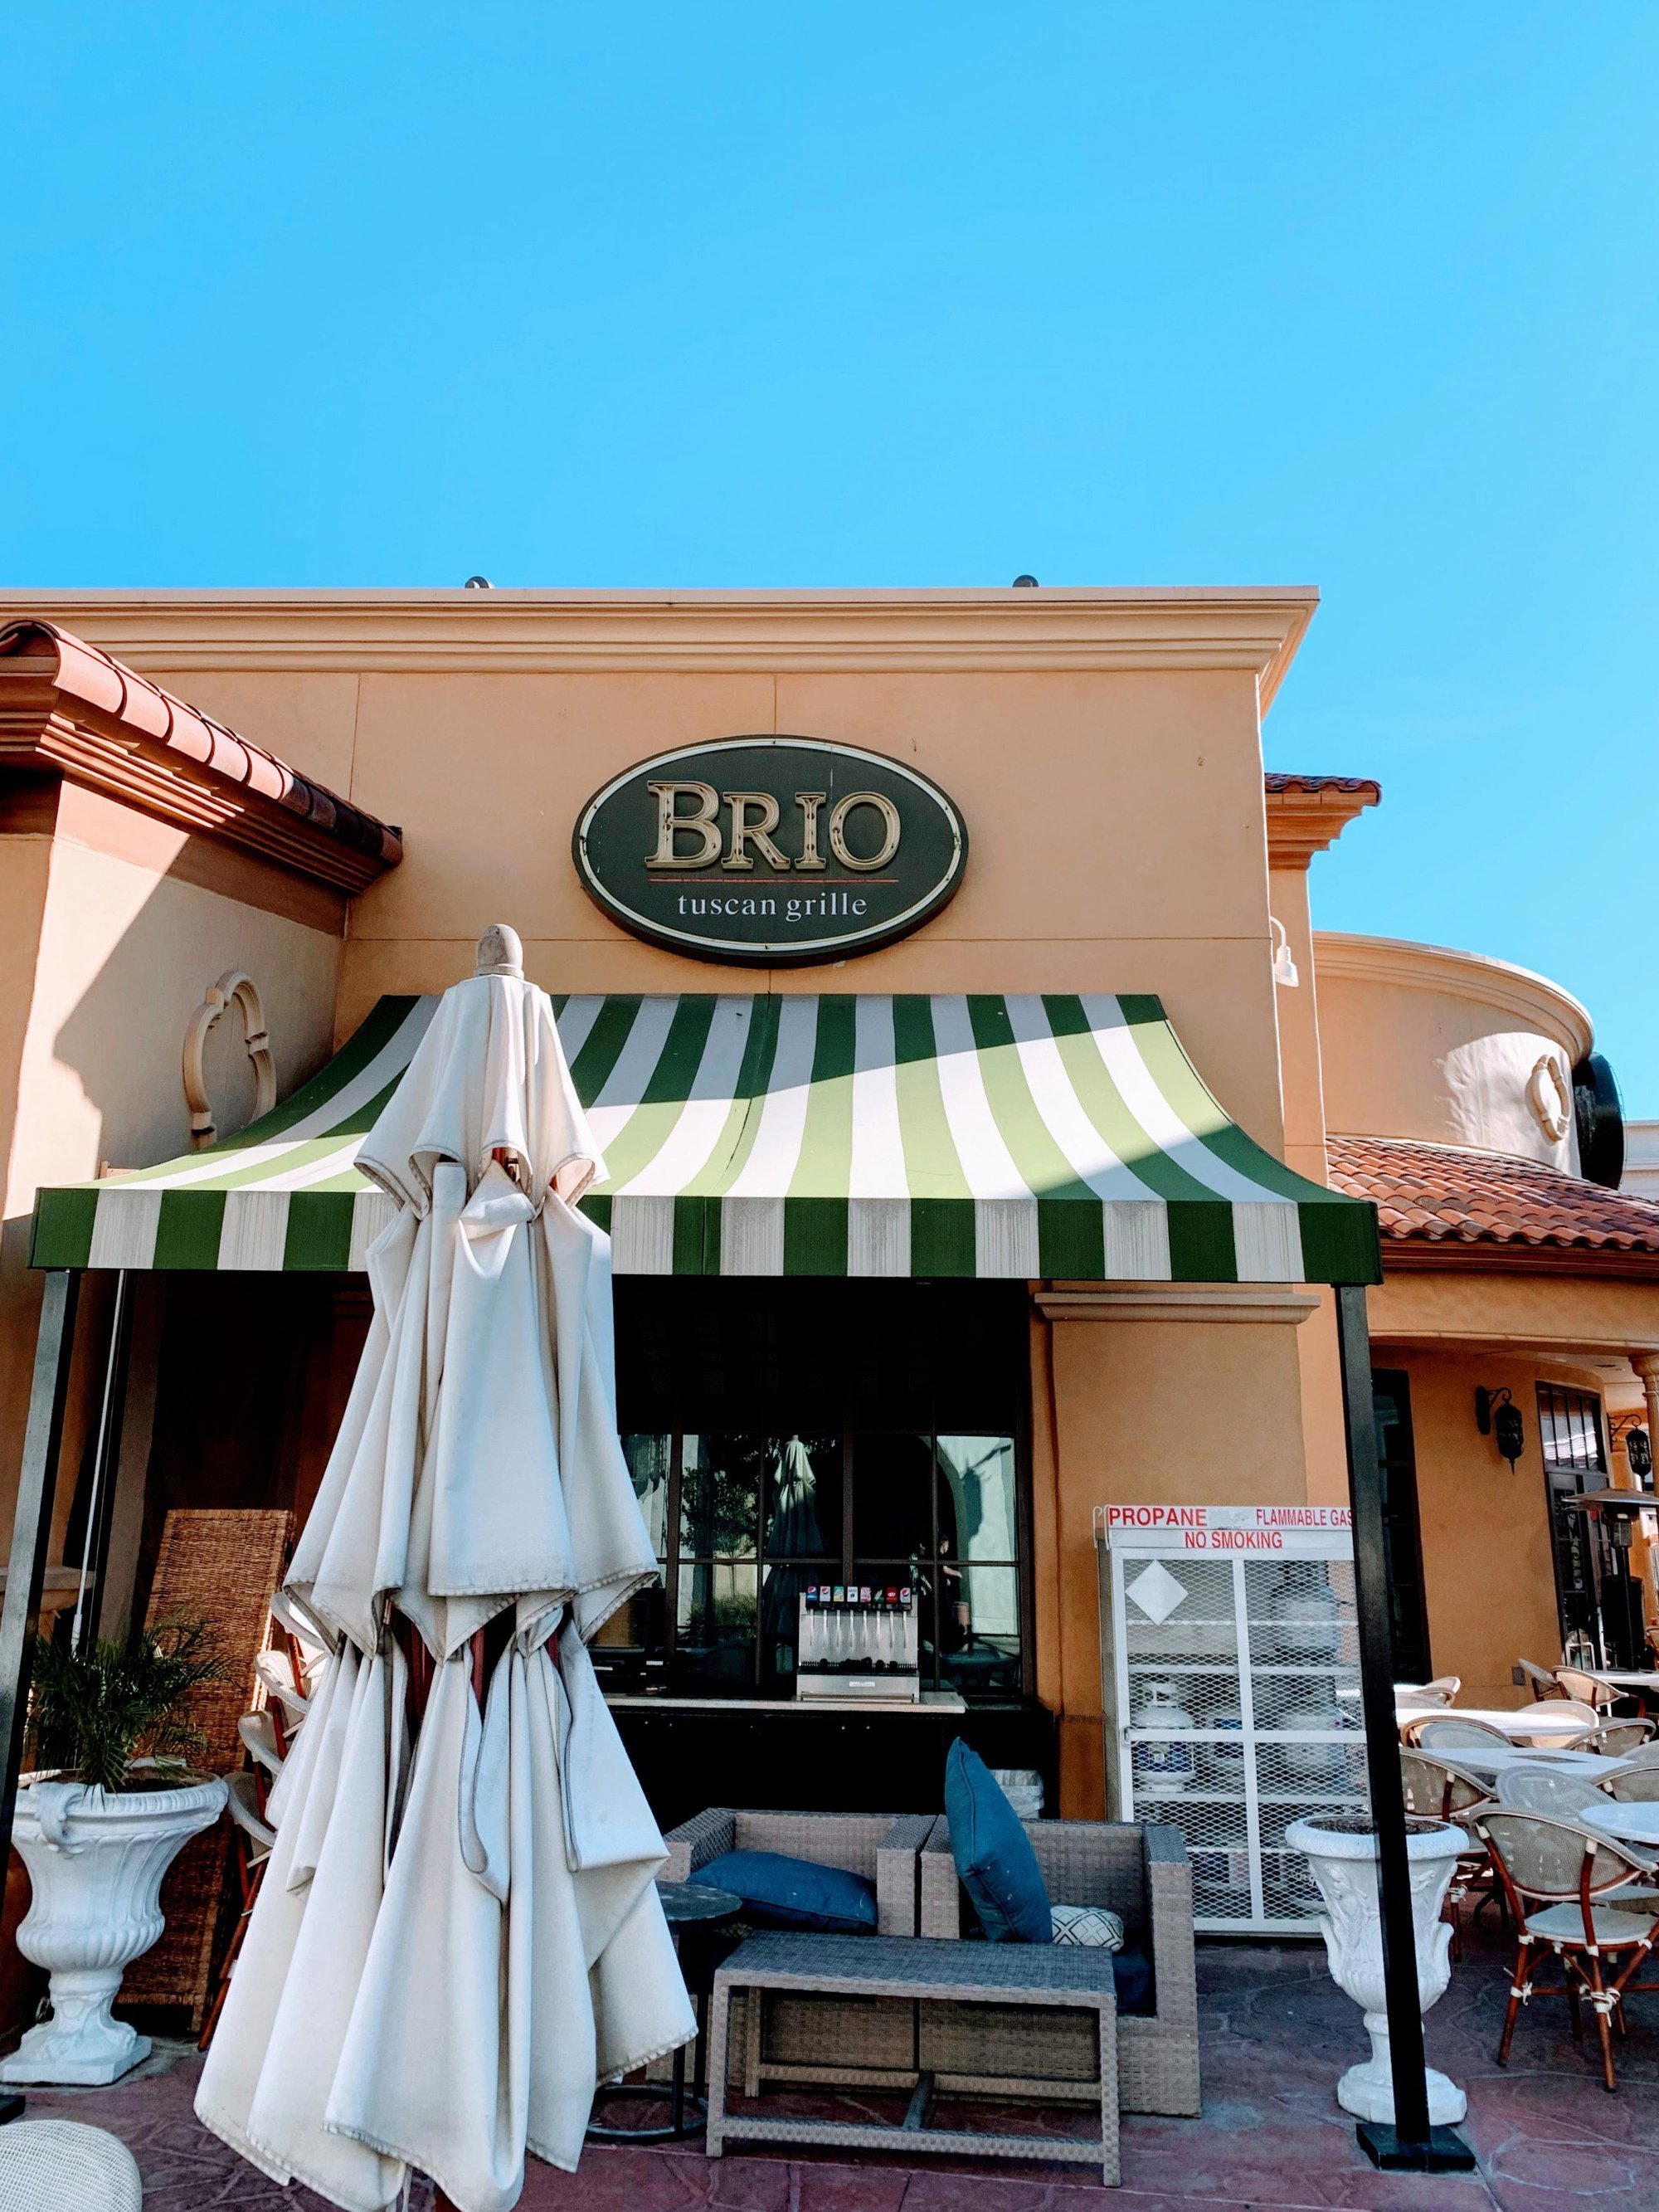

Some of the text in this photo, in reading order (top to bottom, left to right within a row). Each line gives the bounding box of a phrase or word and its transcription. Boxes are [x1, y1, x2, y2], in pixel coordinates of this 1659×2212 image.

[645, 780, 901, 870] BRIO
[678, 892, 868, 922] tuscan grille
[1108, 1507, 1208, 1527] PROPANE
[1256, 1508, 1326, 1527] FLAMMABLE
[1185, 1531, 1283, 1549] NO SMOKING
